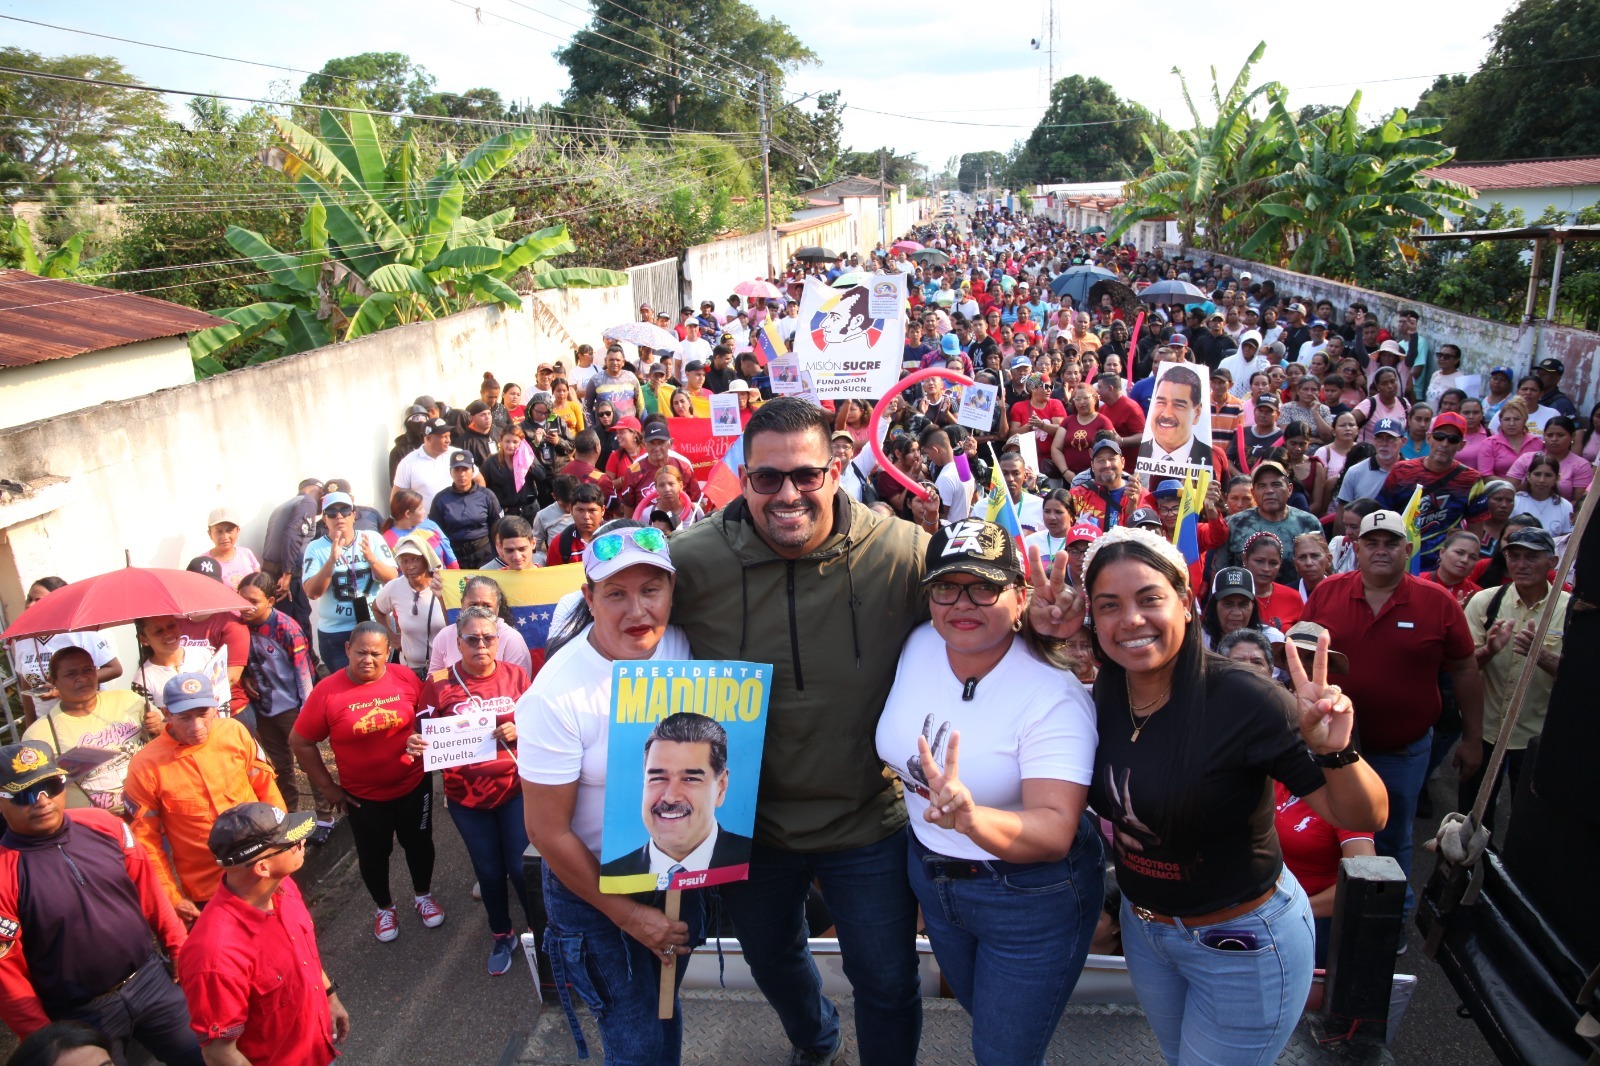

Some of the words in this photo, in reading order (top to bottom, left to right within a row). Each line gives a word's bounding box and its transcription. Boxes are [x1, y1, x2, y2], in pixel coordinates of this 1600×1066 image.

[805, 359, 841, 371] MISIÓN
[842, 361, 881, 371] SUCRE
[1373, 513, 1386, 526] P
[1073, 527, 1098, 539] VZLA
[1228, 573, 1241, 581] CCS
[331, 567, 373, 602] 87
[619, 666, 763, 679] PRESIDENTE
[616, 677, 763, 724] MADURO
[425, 725, 451, 735] #Los
[432, 736, 483, 750] Queremos
[430, 751, 477, 764] DeVuelta.
[1128, 852, 1180, 872] NOSOTROS
